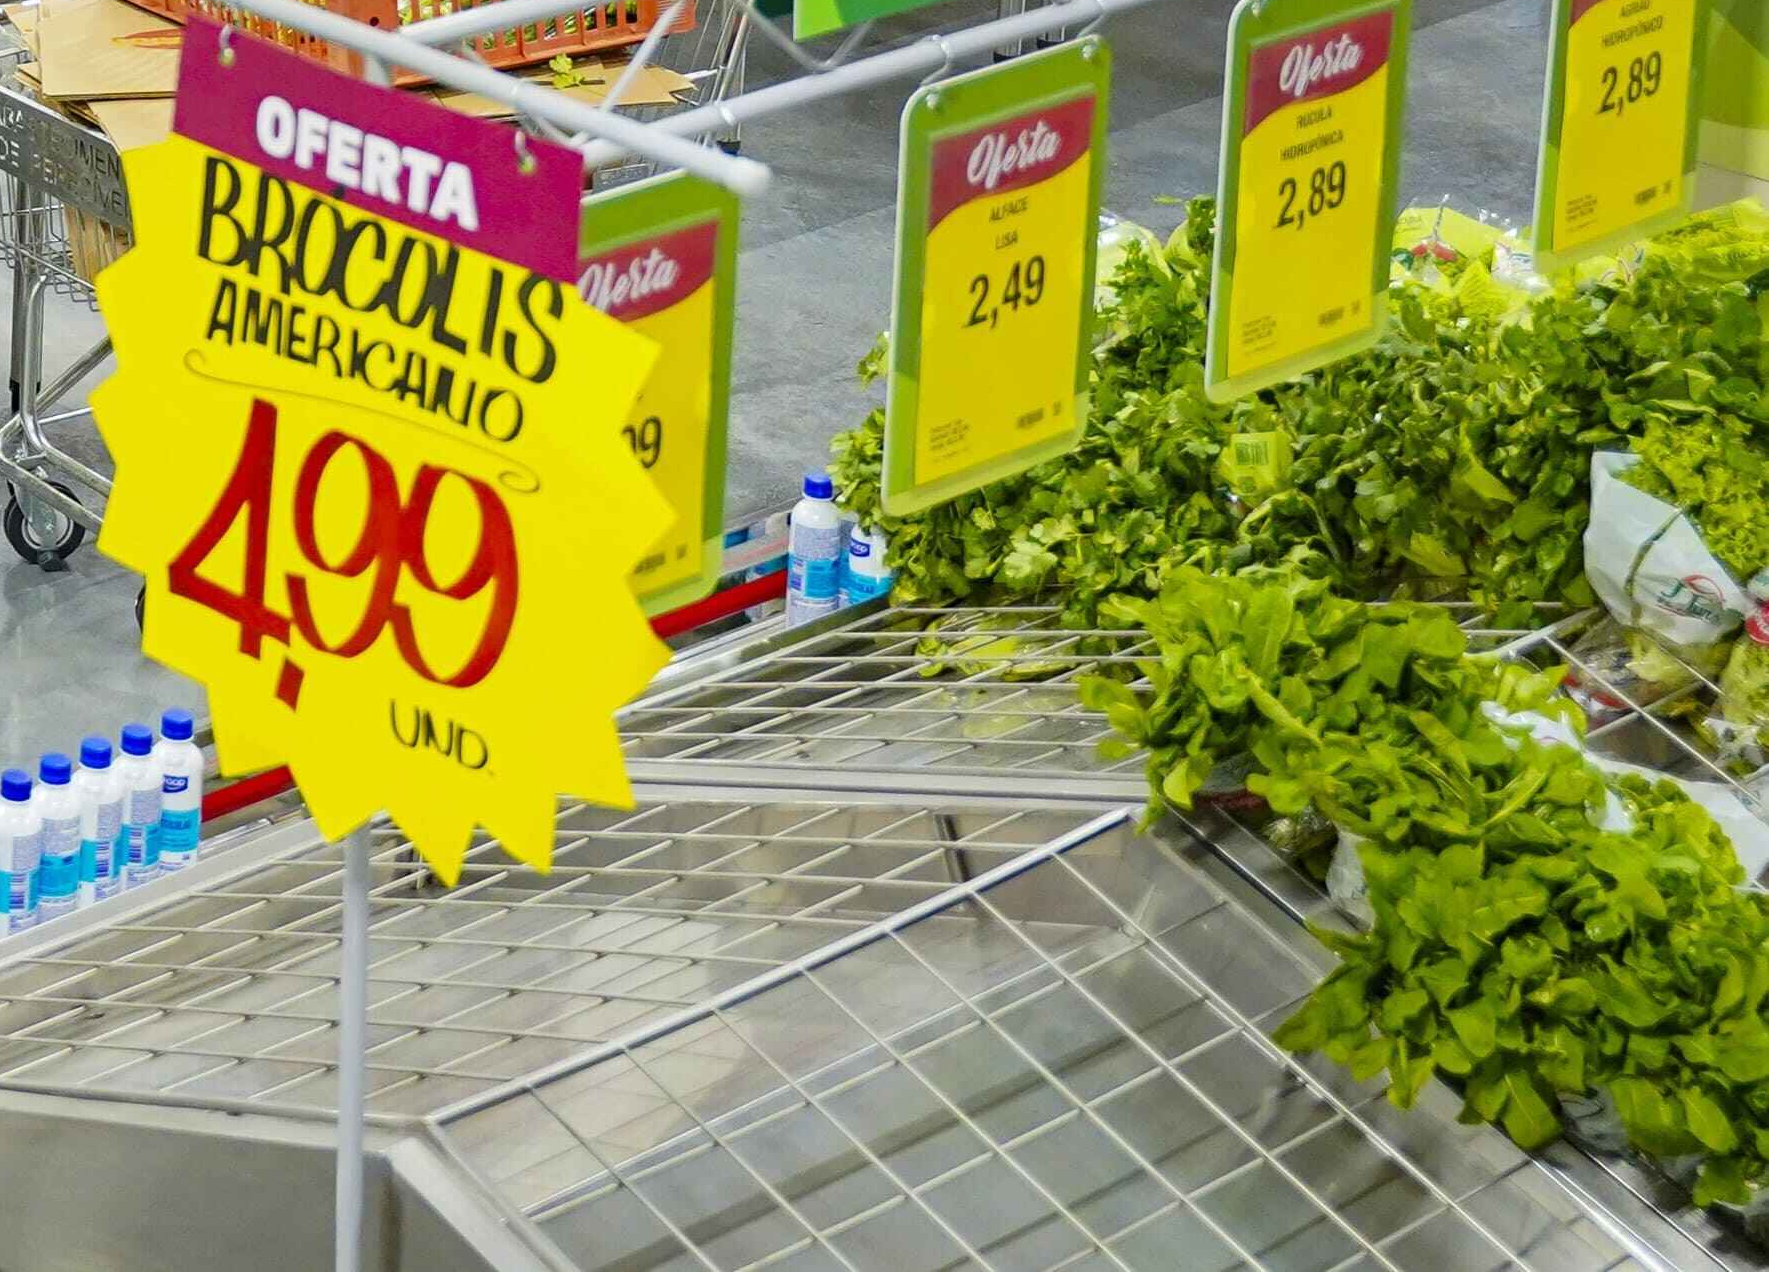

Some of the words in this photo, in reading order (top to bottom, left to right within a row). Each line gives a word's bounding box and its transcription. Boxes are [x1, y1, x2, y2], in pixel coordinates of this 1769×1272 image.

[1279, 31, 1363, 100] Oferta
[1598, 49, 1663, 117] 2,89
[255, 95, 478, 232] OFERTA
[966, 117, 1062, 190] Oferta
[1276, 159, 1347, 233] 2,89
[966, 254, 1046, 328] 2,49
[206, 278, 524, 444] AMERICANO
